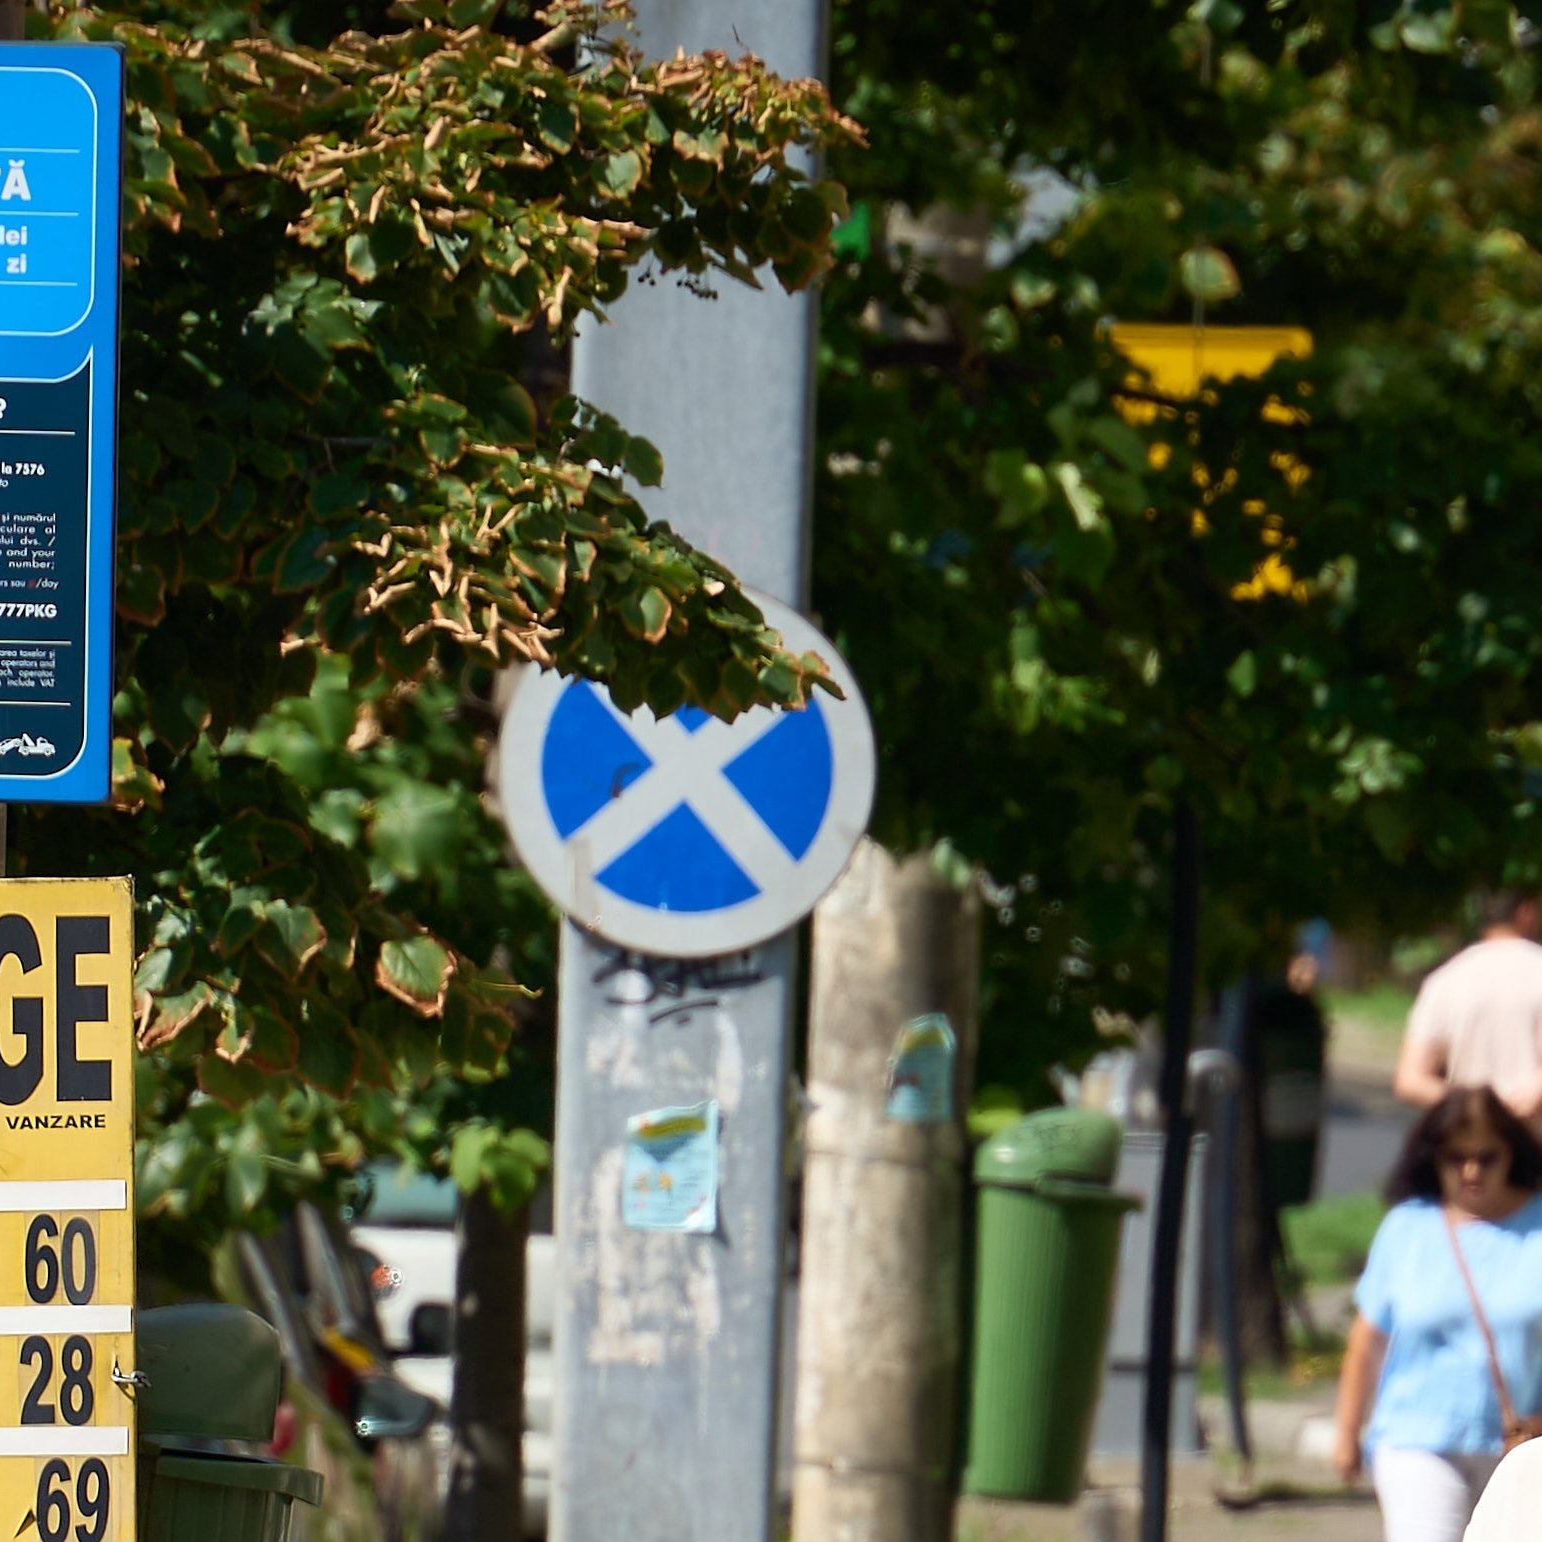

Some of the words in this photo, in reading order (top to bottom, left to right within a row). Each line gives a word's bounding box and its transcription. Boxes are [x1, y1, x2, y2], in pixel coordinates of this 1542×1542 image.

[6, 252, 27, 273] zi
[1, 461, 13, 475] la
[13, 512, 56, 523] numărul
[44, 525, 56, 535] al
[6, 548, 28, 557] and
[32, 549, 55, 559] your
[5, 1113, 107, 1131] VANZARE
[25, 1213, 98, 1307] 60
[19, 1335, 94, 1426] 28
